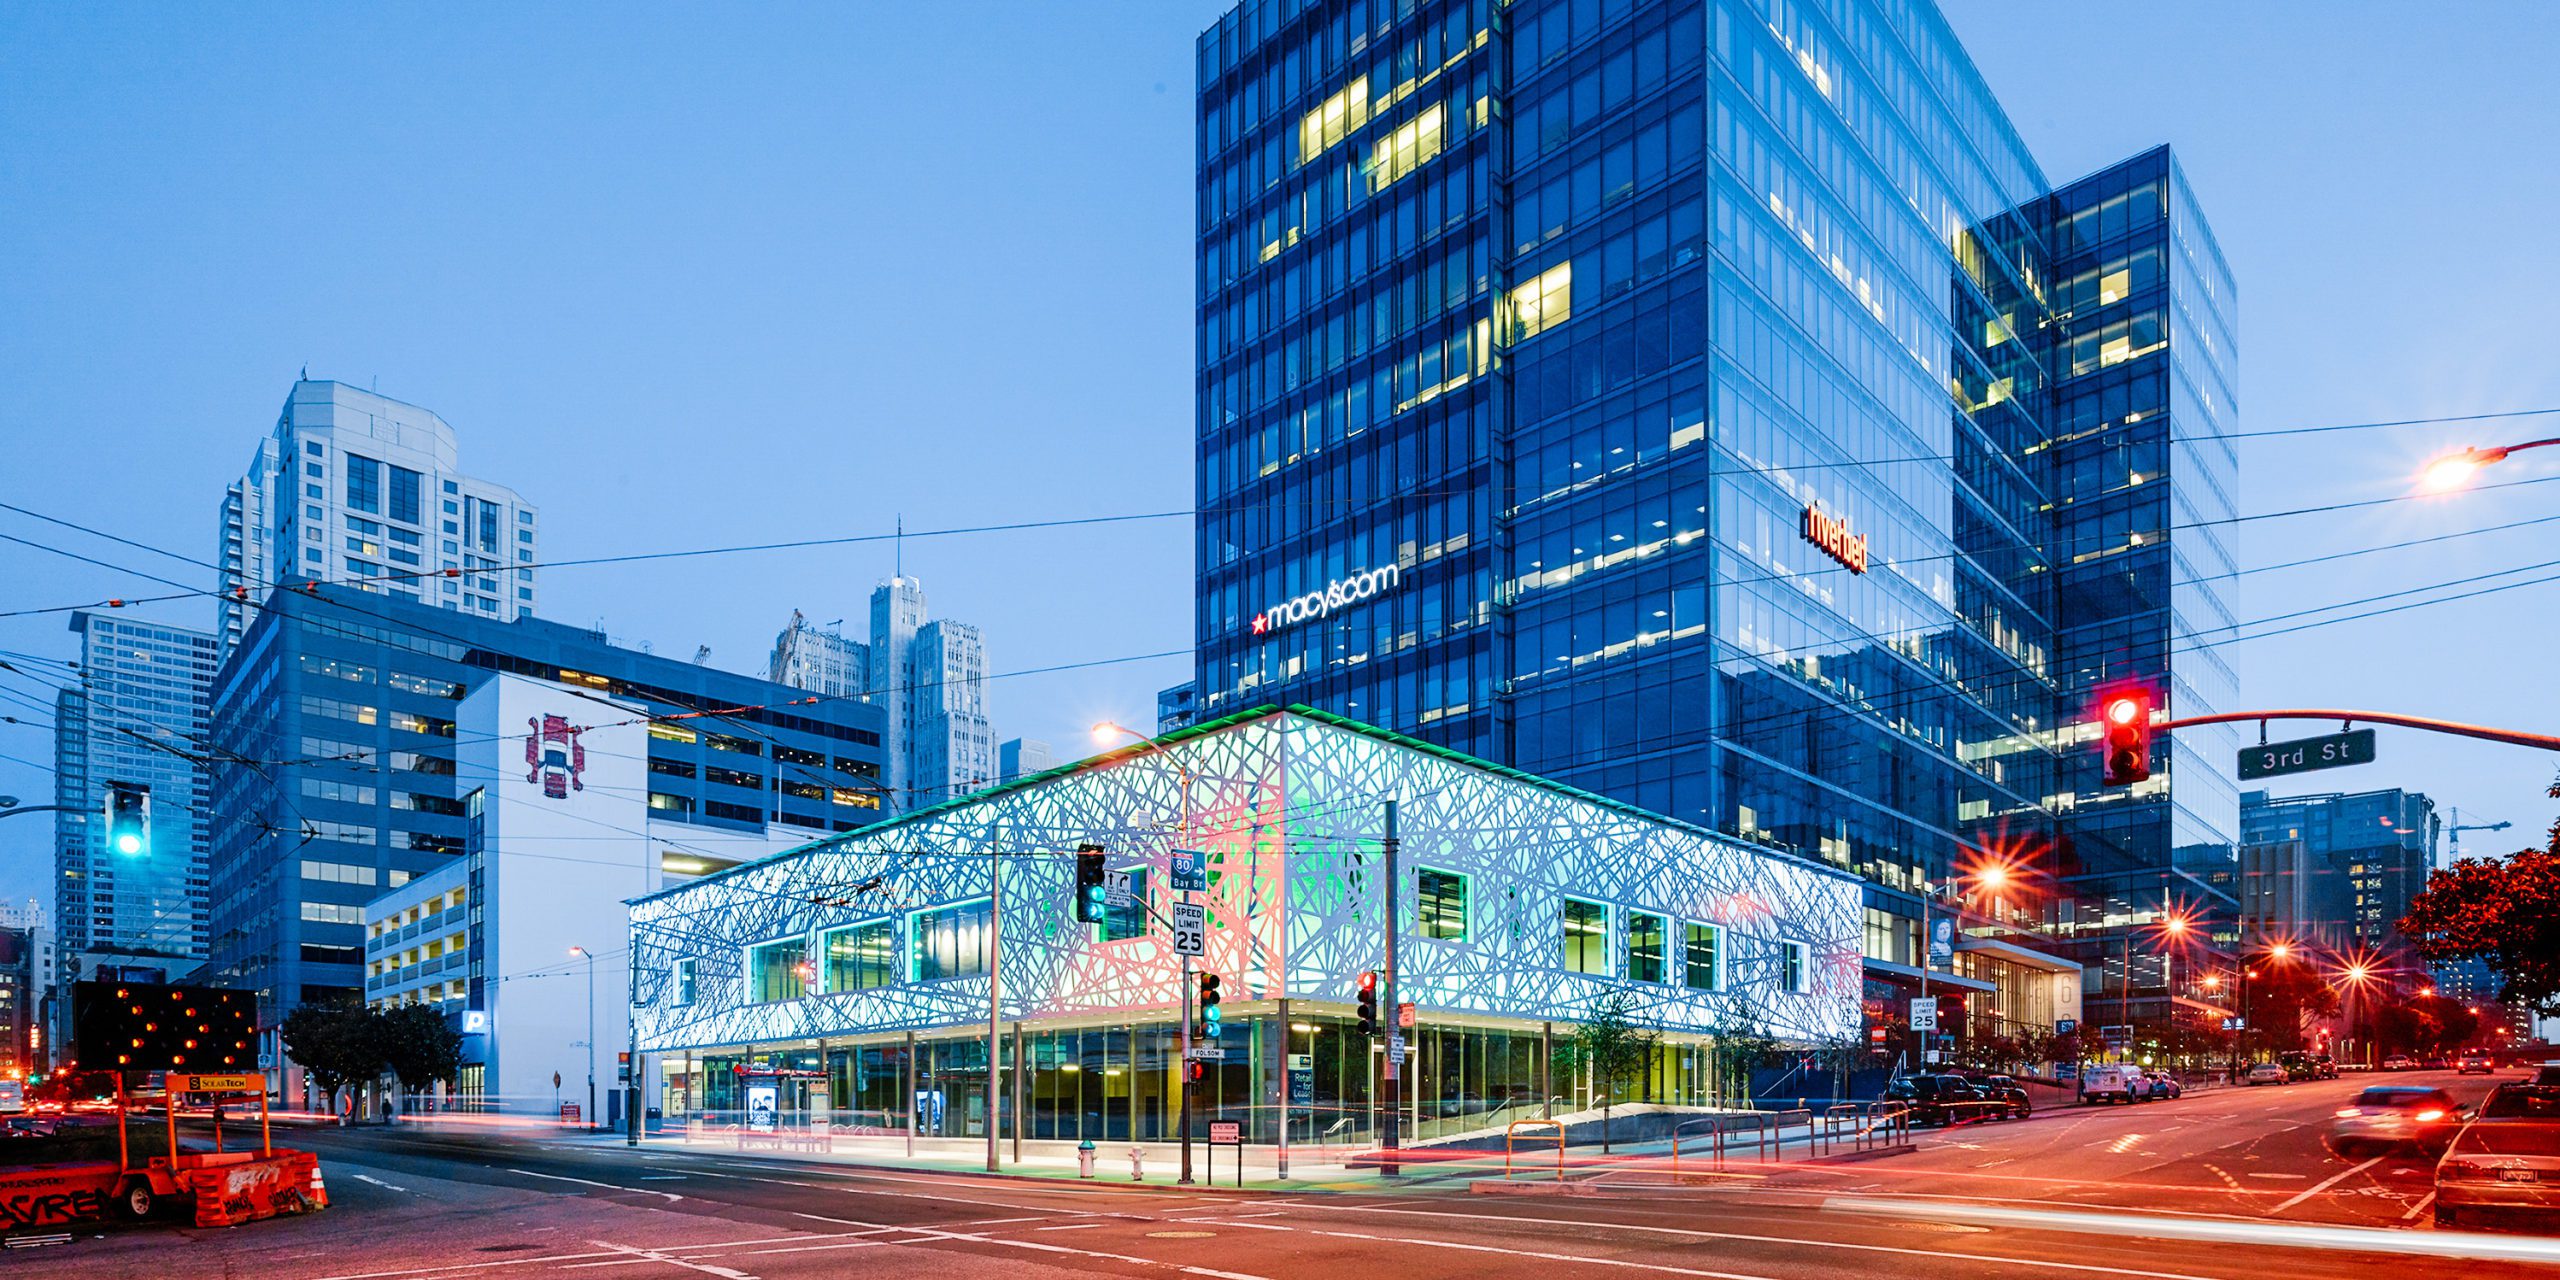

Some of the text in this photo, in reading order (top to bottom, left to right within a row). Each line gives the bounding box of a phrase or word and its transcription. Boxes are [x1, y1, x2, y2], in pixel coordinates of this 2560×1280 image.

[1803, 498, 1868, 574] riverbed
[2262, 741, 2349, 770] 3rd St
[1176, 859, 1190, 870] 80
[1174, 878, 1203, 888] Bay Br
[1176, 907, 1202, 918] SPEED
[1178, 920, 1199, 929] LIMIT
[1177, 931, 1202, 951] 25
[1914, 1017, 1934, 1027] 25
[1294, 1073, 1312, 1082] Retail
